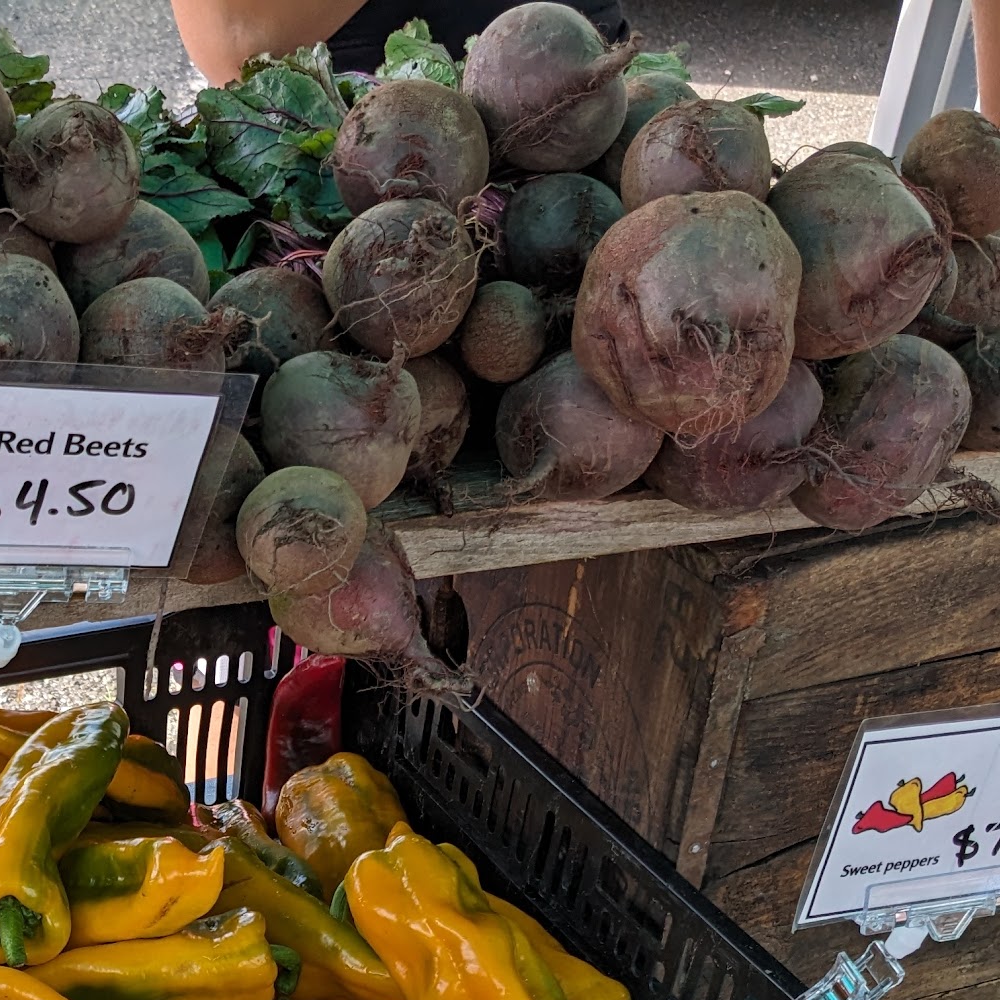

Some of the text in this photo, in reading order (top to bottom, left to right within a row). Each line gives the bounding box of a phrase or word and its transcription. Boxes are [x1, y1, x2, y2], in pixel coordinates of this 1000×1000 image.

[63, 432, 149, 459] Beets
[840, 855, 940, 878] Sweet peppers
